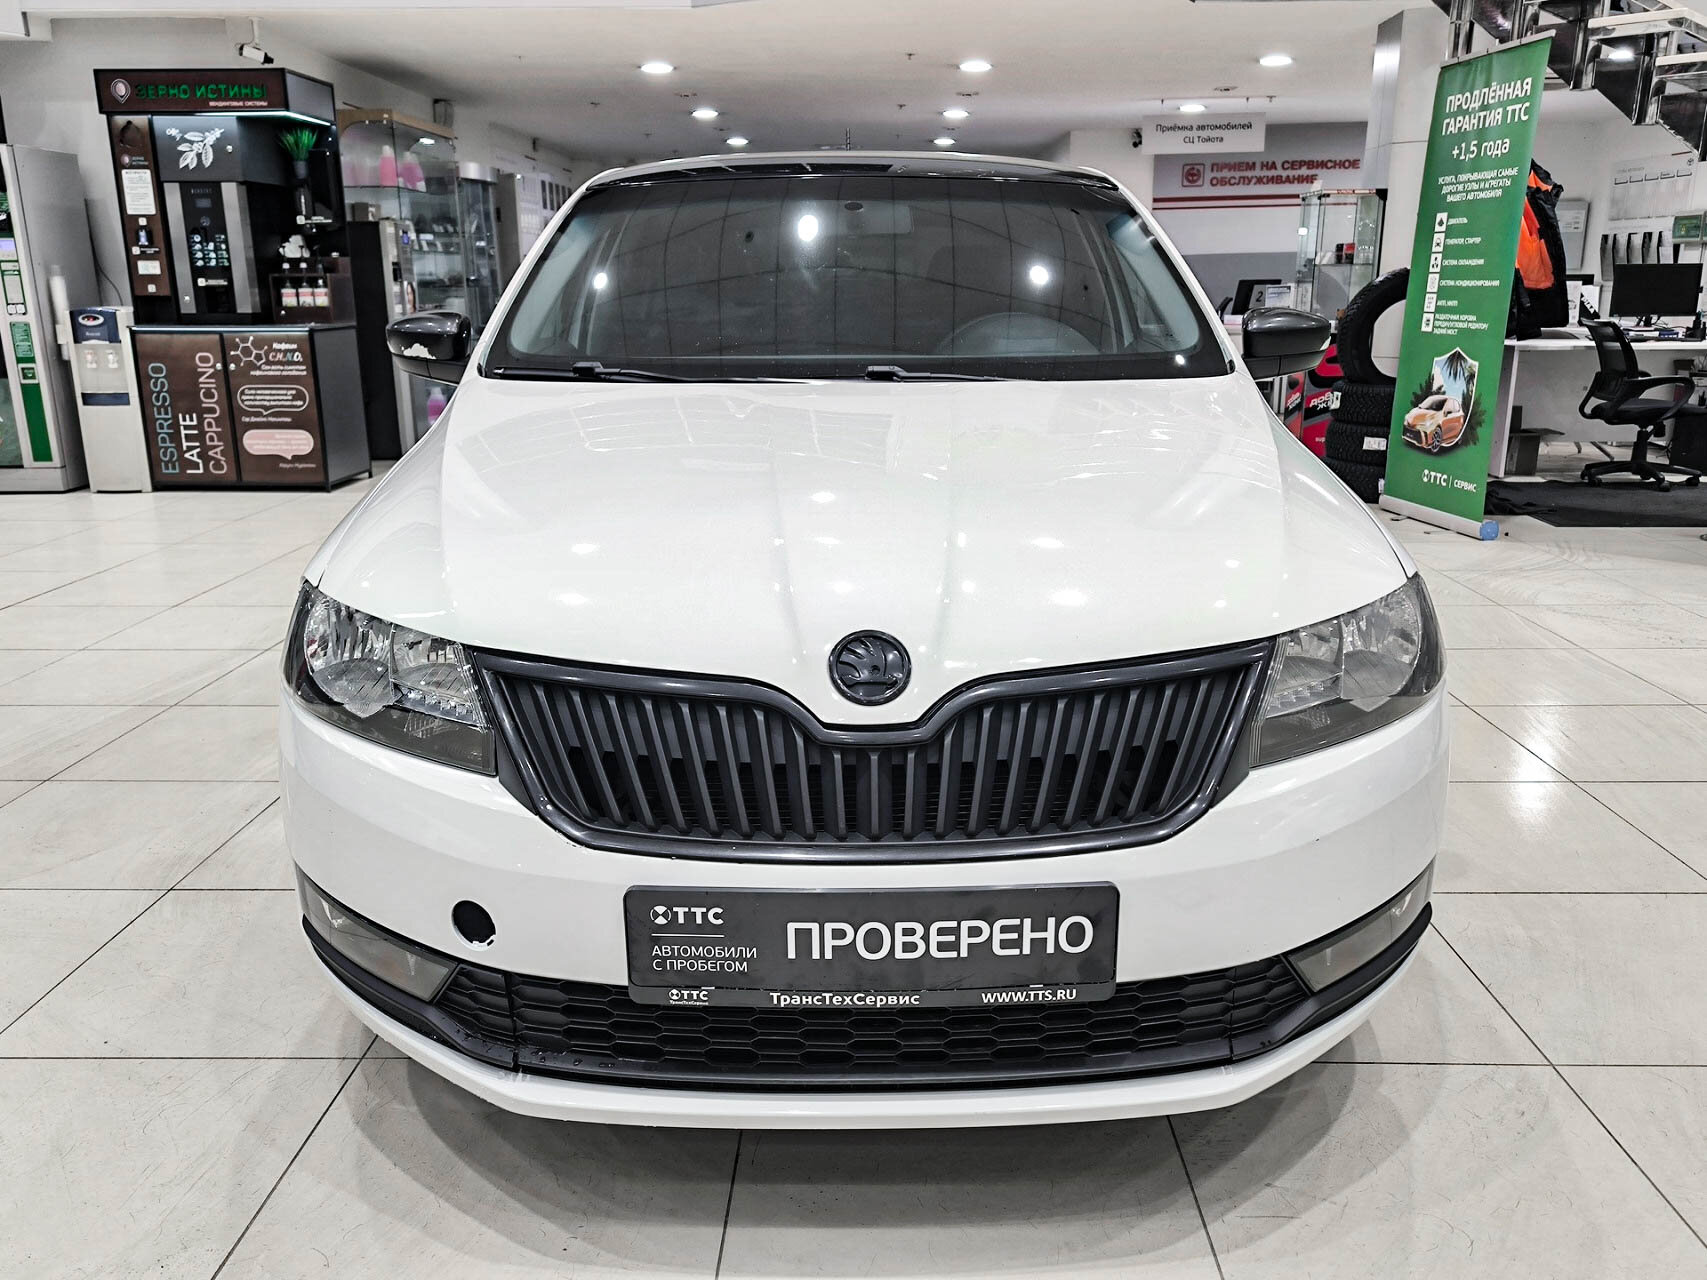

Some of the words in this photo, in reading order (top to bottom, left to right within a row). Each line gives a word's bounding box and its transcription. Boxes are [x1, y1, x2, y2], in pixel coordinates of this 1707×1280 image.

[135, 84, 190, 99] ЗЕРНО
[195, 83, 267, 99] ИСТИНЫ
[1446, 77, 1532, 113] ПРОДЛЁННАЯ
[1156, 123, 1193, 133] Приёмка
[1195, 121, 1253, 132] автомобилей
[1442, 108, 1503, 136] ГАРАНТИЯ
[1506, 102, 1530, 124] ТТС
[1183, 136, 1195, 145] СЦ
[1197, 135, 1224, 144] Тойота
[1452, 140, 1478, 161] +1,5
[1481, 138, 1510, 158] года
[1211, 162, 1256, 173] ПРИЕМ
[1260, 161, 1277, 171] НА
[1282, 159, 1361, 171] СЕРВИСНОЕ
[1498, 166, 1519, 177] САМЫЕ
[1210, 174, 1318, 187] ОБСЛУЖИВАНИЕ
[148, 363, 179, 473] ESPRESSO
[195, 352, 227, 474] CAPPUCINO
[179, 413, 204, 474] LATTE
[1430, 471, 1448, 486] ТТС
[1453, 479, 1477, 492] СЕРВИС
[673, 906, 724, 925] ТТС
[786, 915, 1094, 960] ПРОВЕРЕНО
[651, 945, 757, 960] АВТОМОБИЛИ
[653, 960, 662, 971] С
[665, 959, 748, 973] ПРОБЕГОМ
[681, 990, 709, 1000] ТТС
[770, 991, 920, 1008] ТрансТехСервис
[981, 988, 1077, 1004] WWW.TTS.RU
